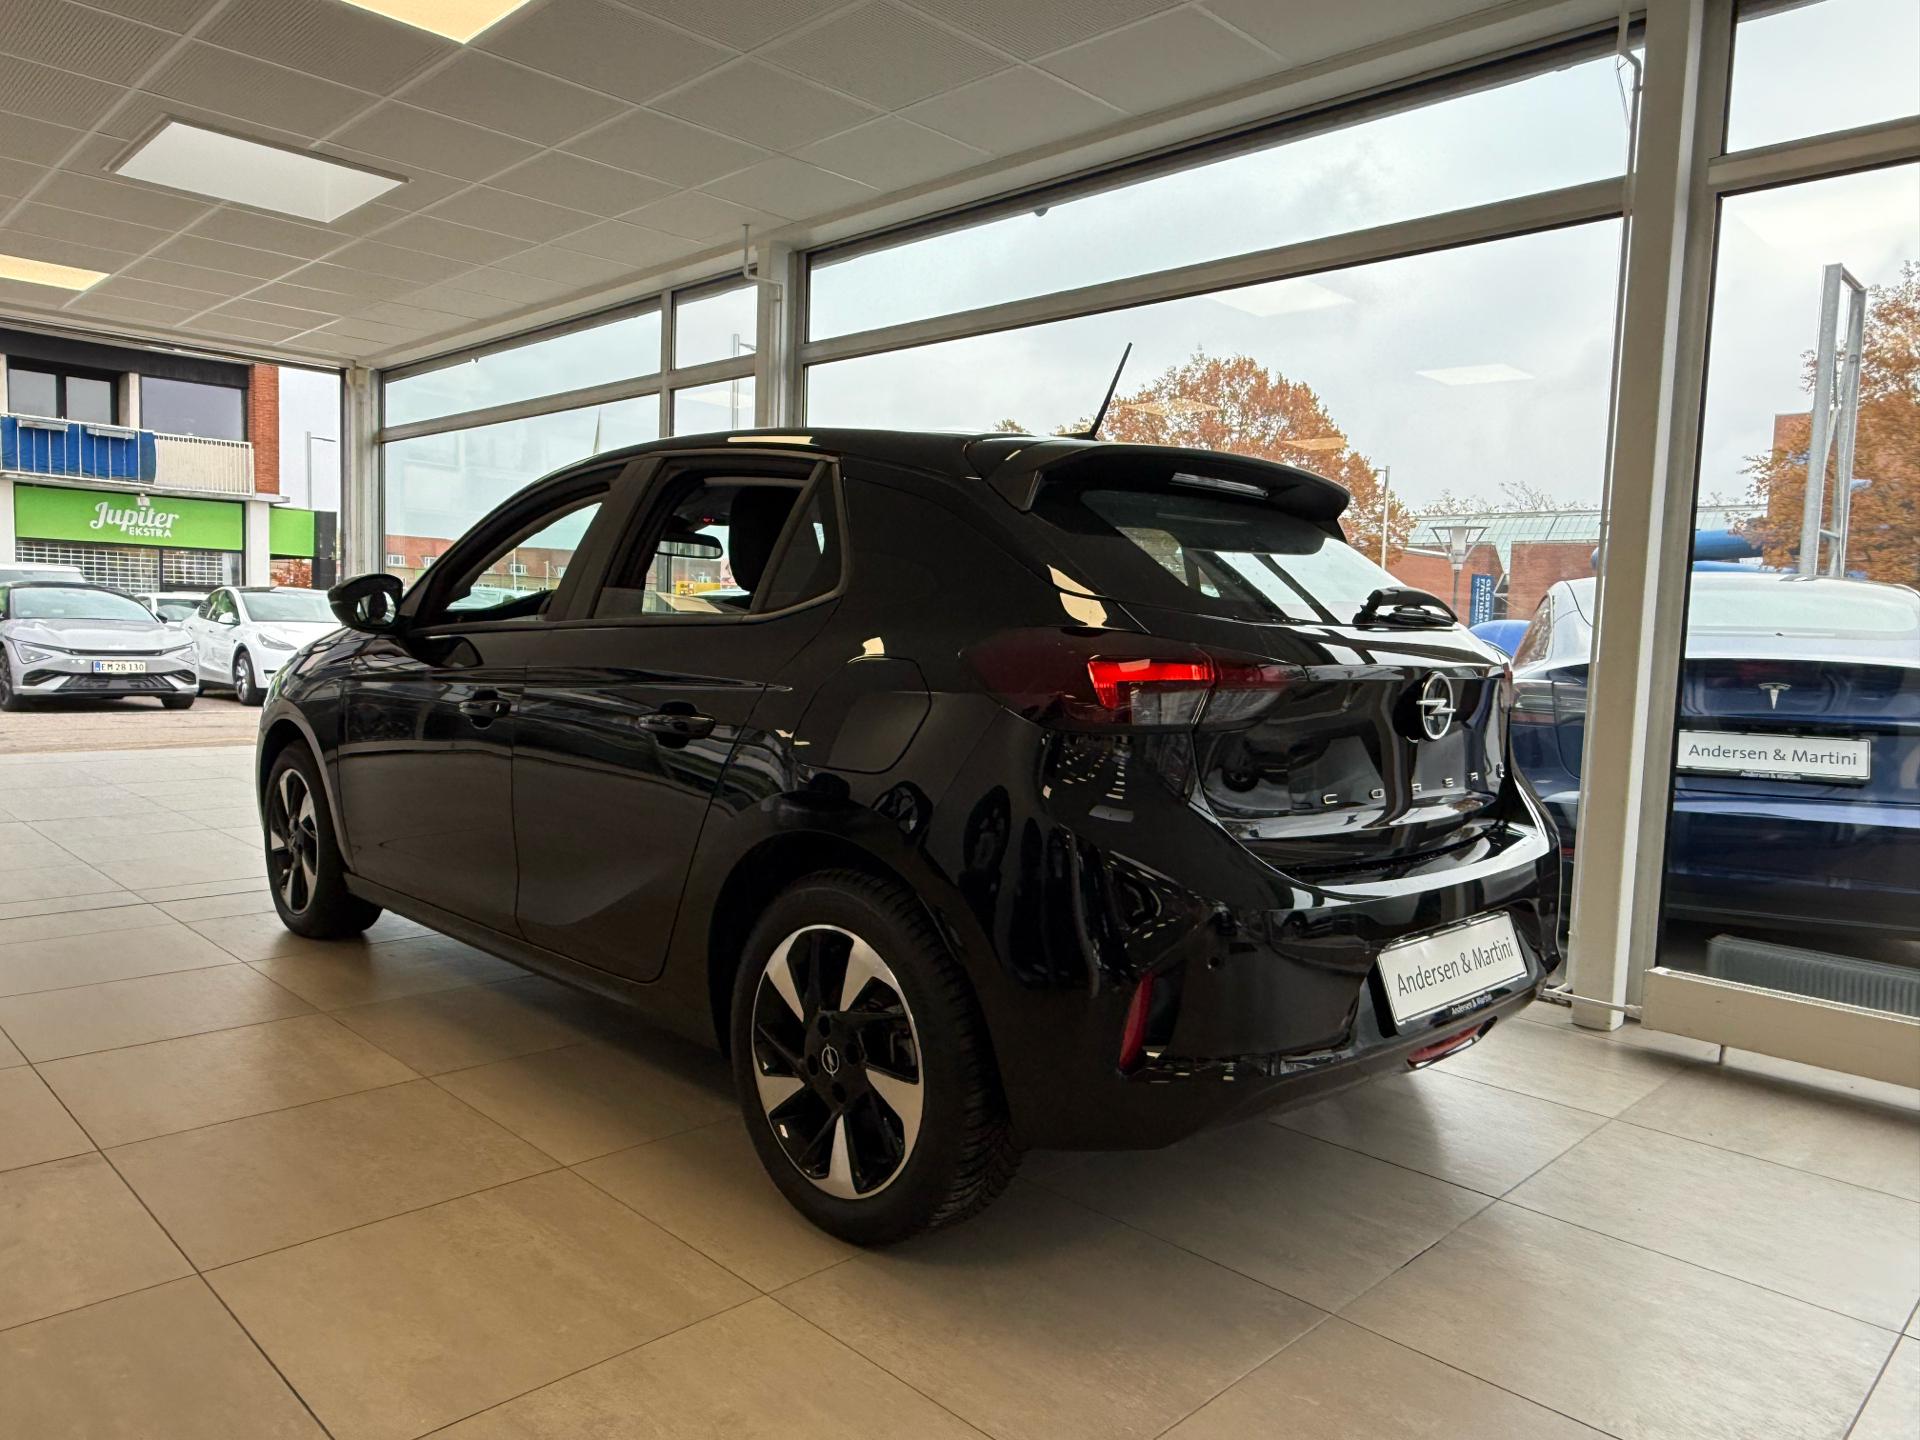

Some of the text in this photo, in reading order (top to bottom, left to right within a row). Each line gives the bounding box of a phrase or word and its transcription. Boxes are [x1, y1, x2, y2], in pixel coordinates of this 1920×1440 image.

[89, 501, 180, 531] Jupiter
[129, 526, 172, 538] EKSTRA
[115, 663, 126, 671] 28
[129, 663, 144, 671] 130
[1688, 744, 1857, 766] Andersen & Martini
[1397, 937, 1514, 997] Andersen & Martini
